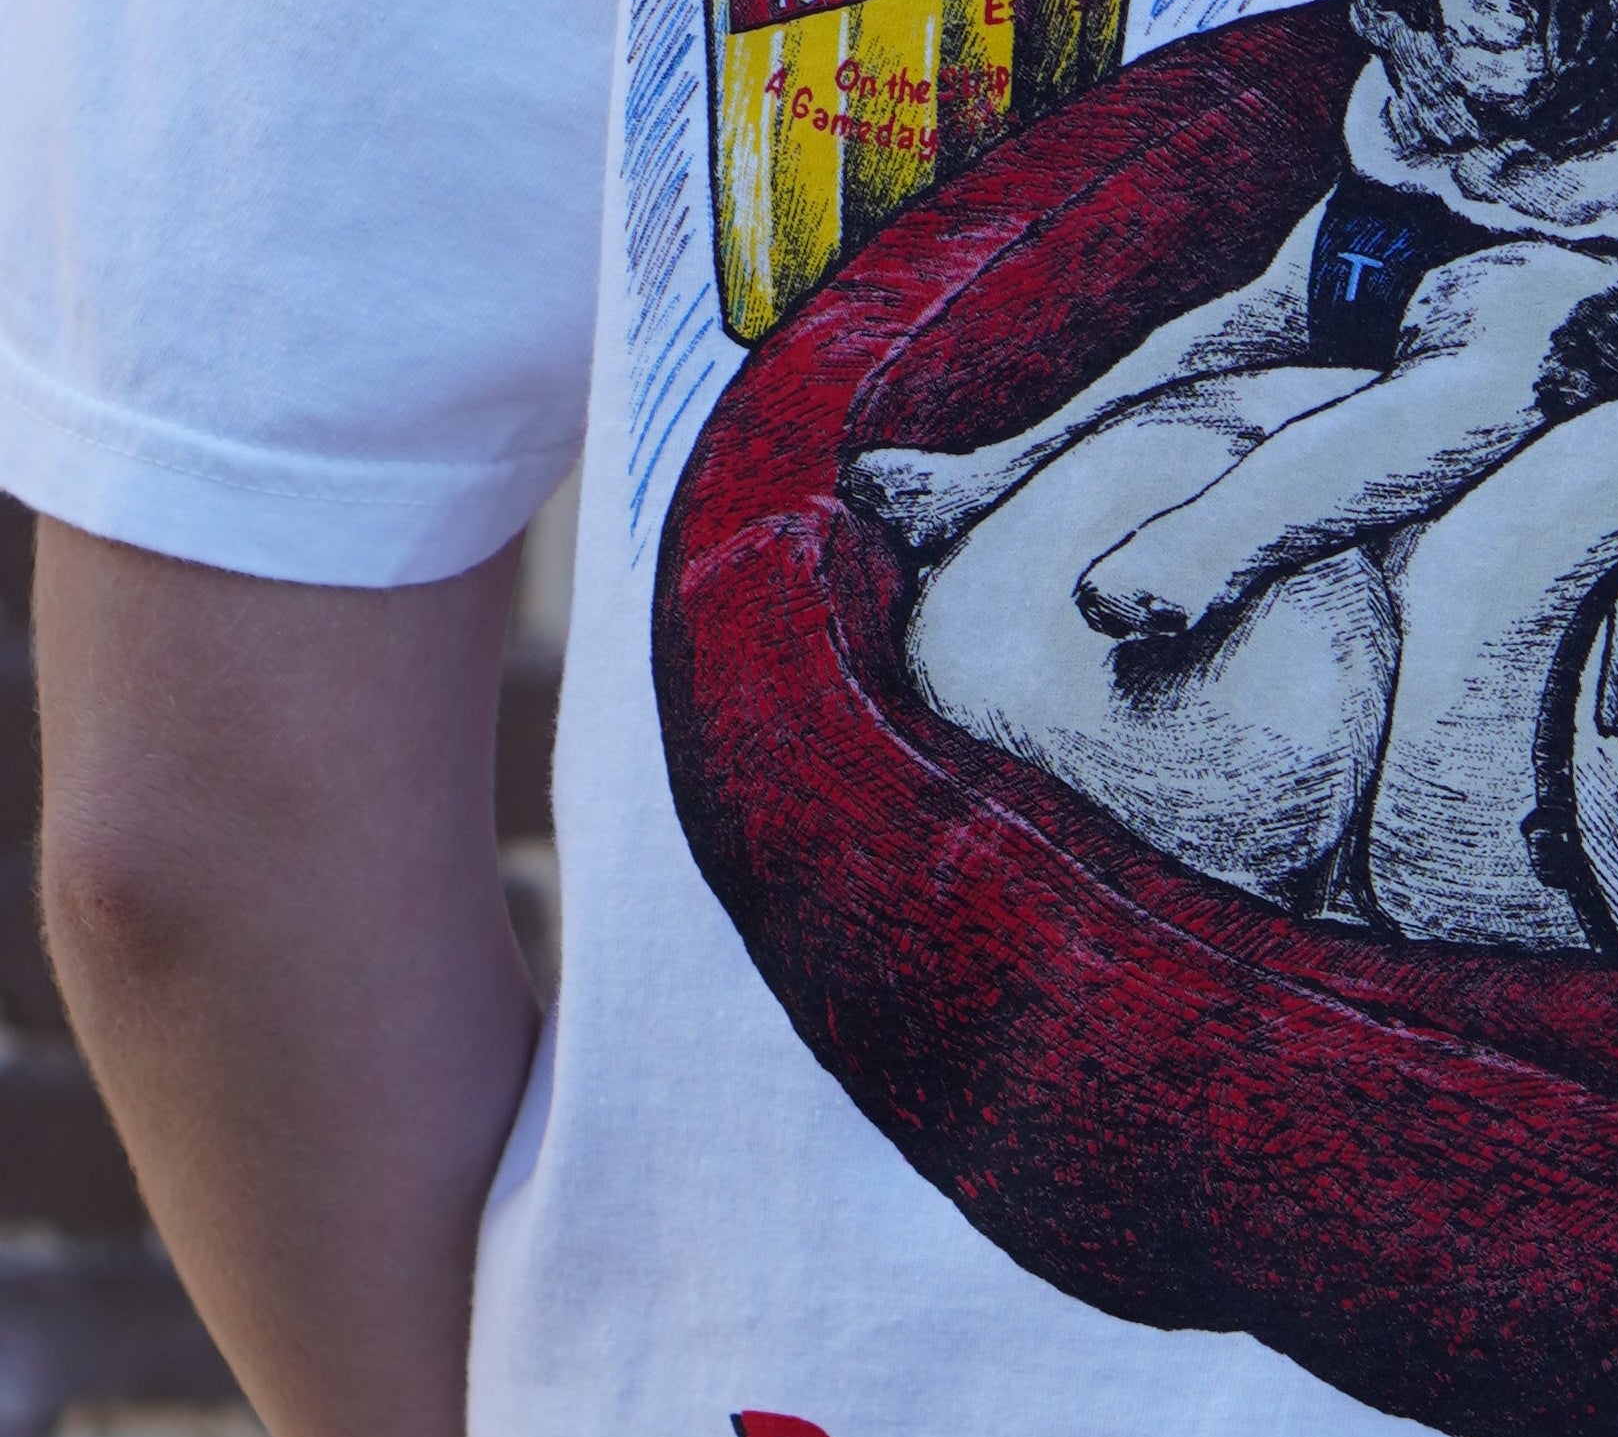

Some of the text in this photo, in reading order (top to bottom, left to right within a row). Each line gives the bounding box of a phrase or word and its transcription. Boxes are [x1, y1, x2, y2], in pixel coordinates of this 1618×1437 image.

[834, 56, 877, 100] On
[884, 66, 931, 105] the
[764, 60, 787, 100] A
[790, 85, 939, 163] Gameday
[1337, 251, 1385, 303] T
